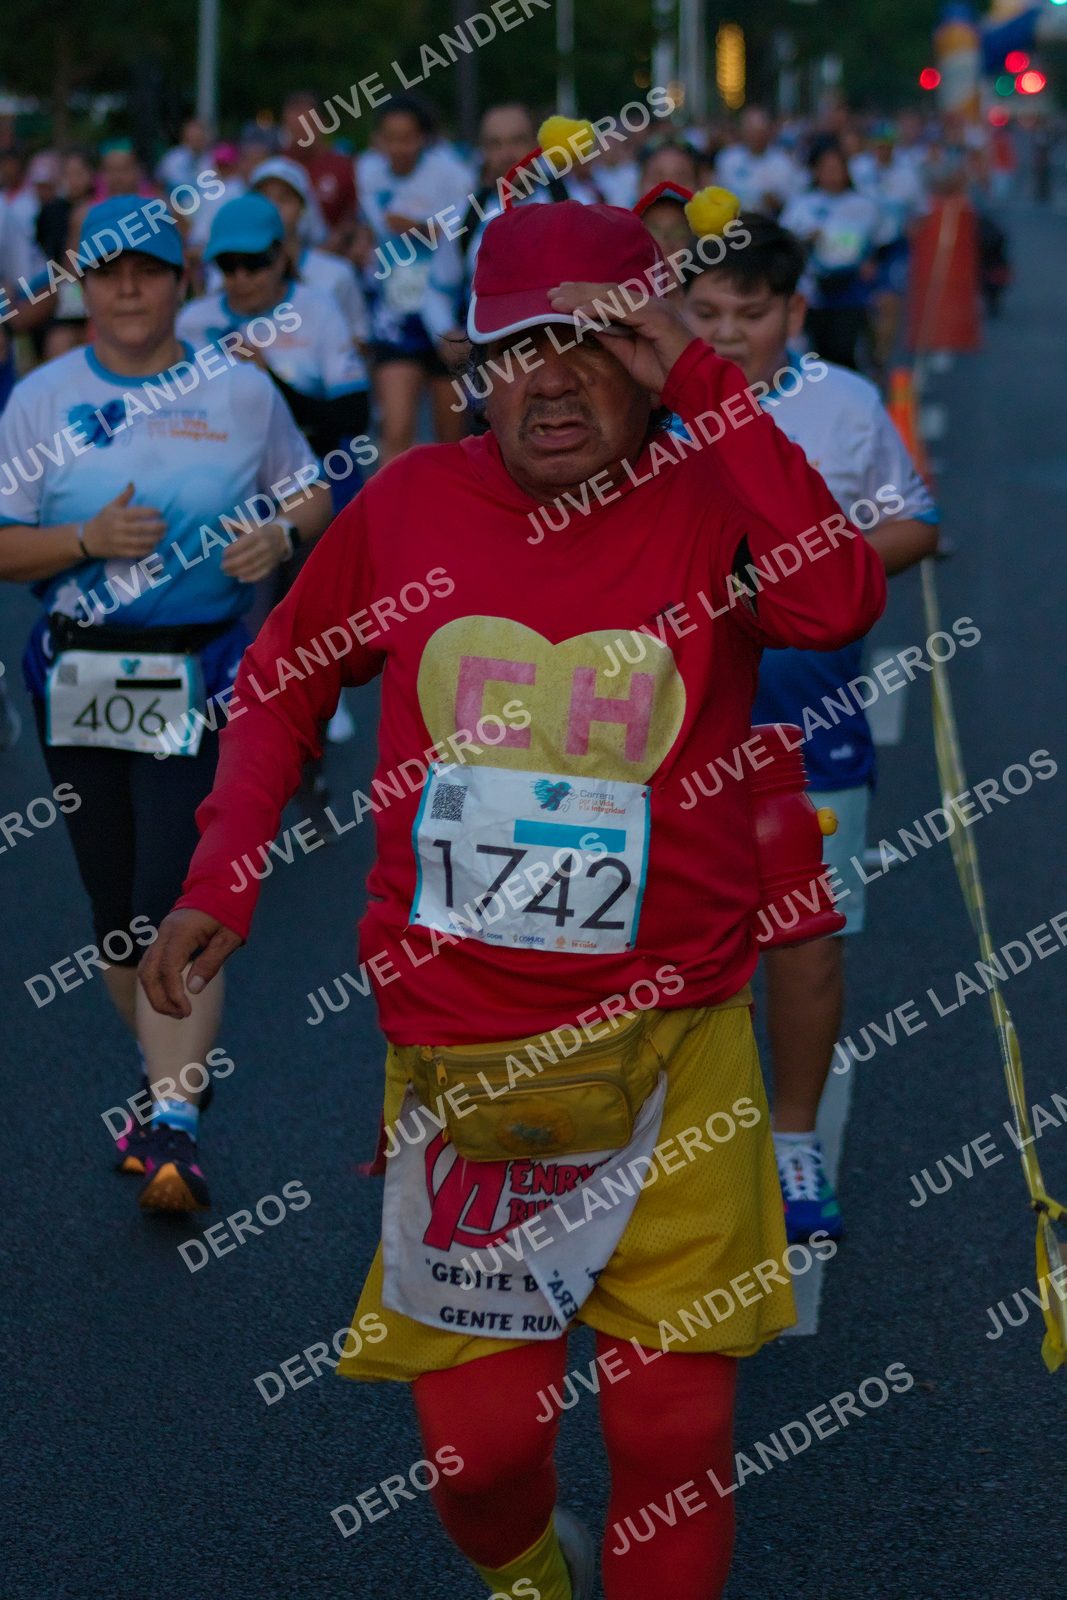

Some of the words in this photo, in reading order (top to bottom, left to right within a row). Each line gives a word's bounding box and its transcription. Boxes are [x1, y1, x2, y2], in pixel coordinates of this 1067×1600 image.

[74, 694, 167, 737] 406
[580, 789, 615, 801] Carrera
[433, 839, 632, 930] 1742
[440, 1307, 513, 1331] GENTE
